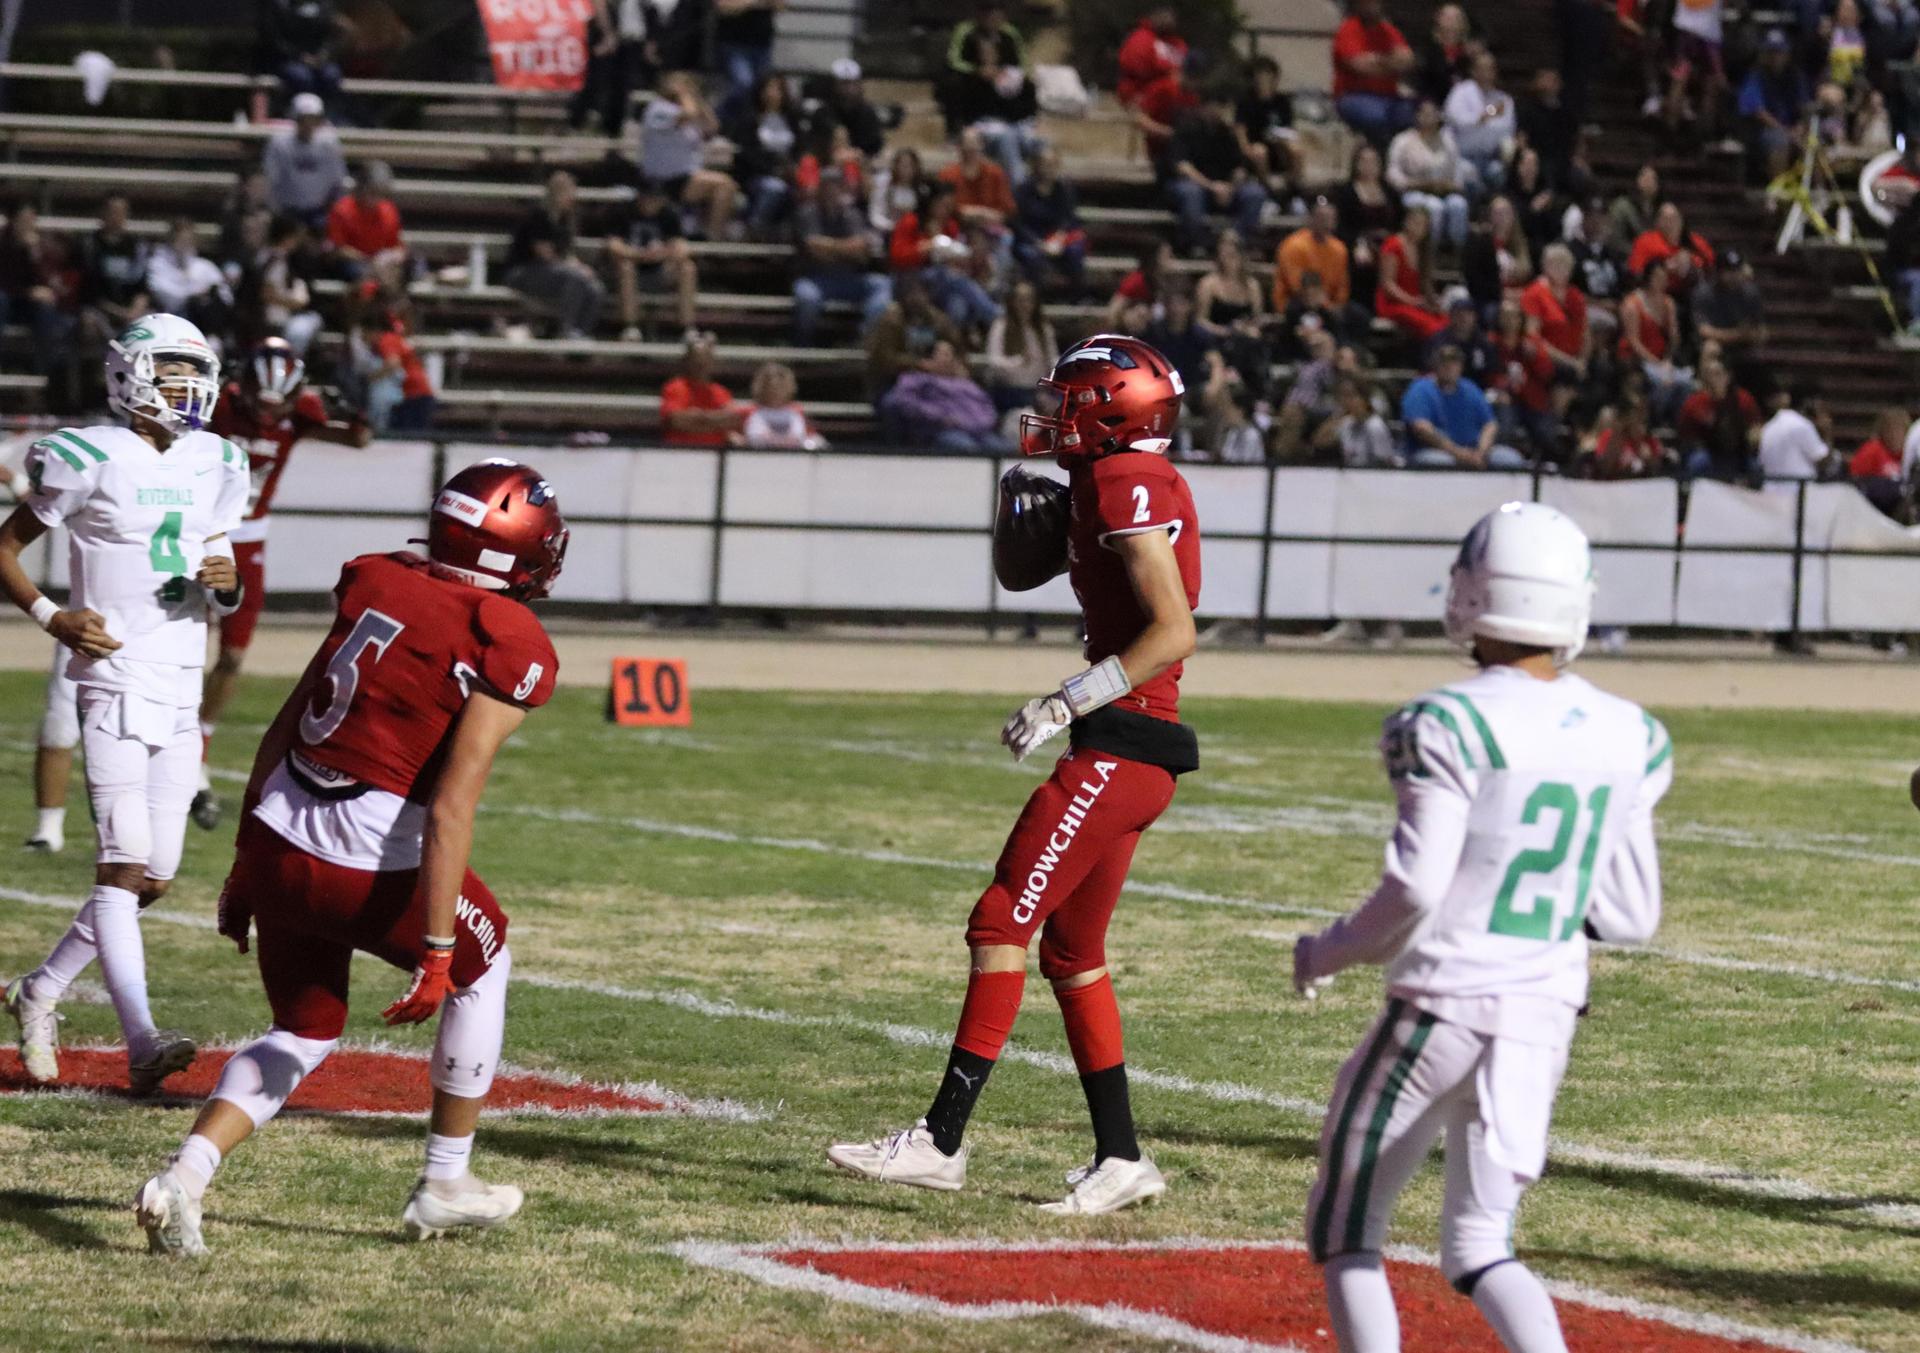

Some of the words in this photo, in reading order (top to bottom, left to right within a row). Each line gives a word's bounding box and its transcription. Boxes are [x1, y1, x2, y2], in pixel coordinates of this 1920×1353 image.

[1131, 485, 1151, 524] 2
[148, 510, 188, 602] 4
[298, 606, 406, 746] 5
[513, 661, 545, 701] 5
[621, 660, 682, 715] 10
[1012, 760, 1118, 924] CHOWCHILLA
[1486, 780, 1612, 942] 21
[455, 894, 498, 967] WCHILL
